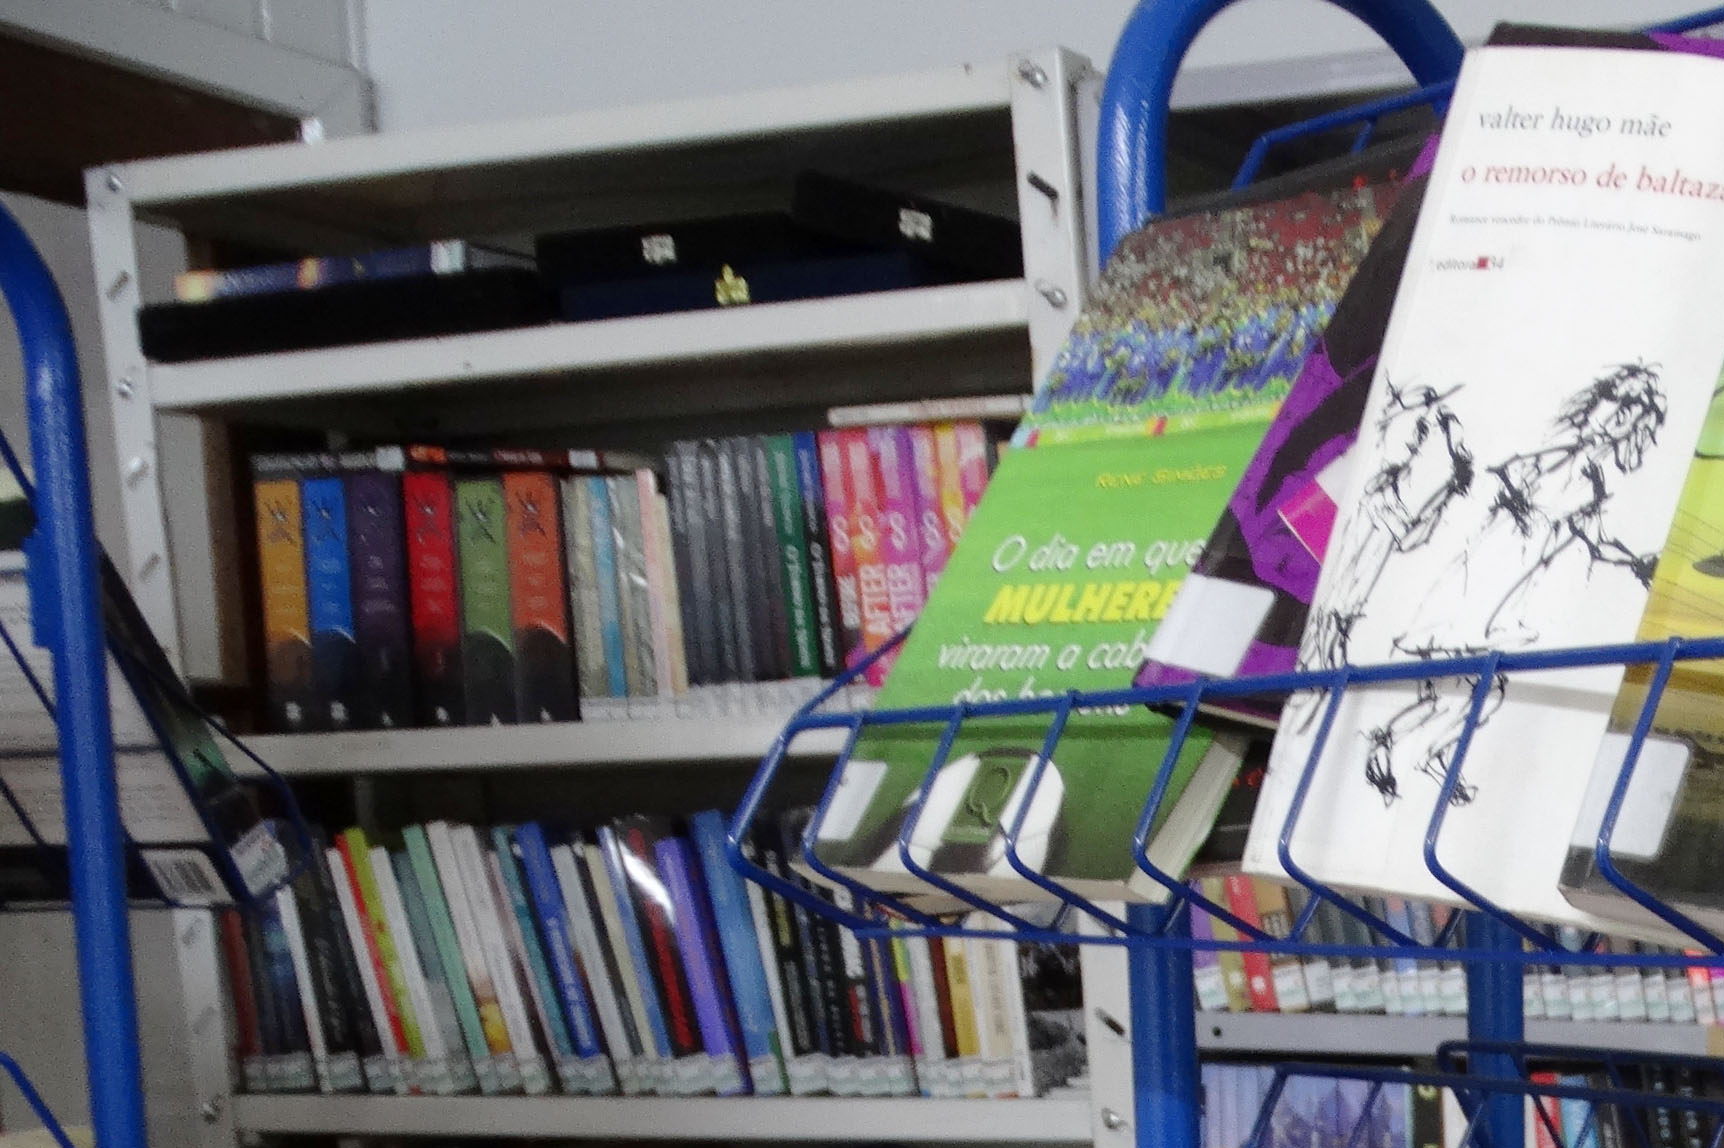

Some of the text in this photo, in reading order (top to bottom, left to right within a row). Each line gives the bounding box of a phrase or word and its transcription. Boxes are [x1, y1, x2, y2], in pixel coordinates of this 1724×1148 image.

[1478, 105, 1672, 138] valter hugo mãe
[1461, 163, 1477, 184] o
[1484, 162, 1588, 188] remorso
[1596, 161, 1628, 190] de
[992, 533, 1206, 575] O dia em que
[938, 634, 1051, 671] viraram
[1056, 643, 1082, 671] a
